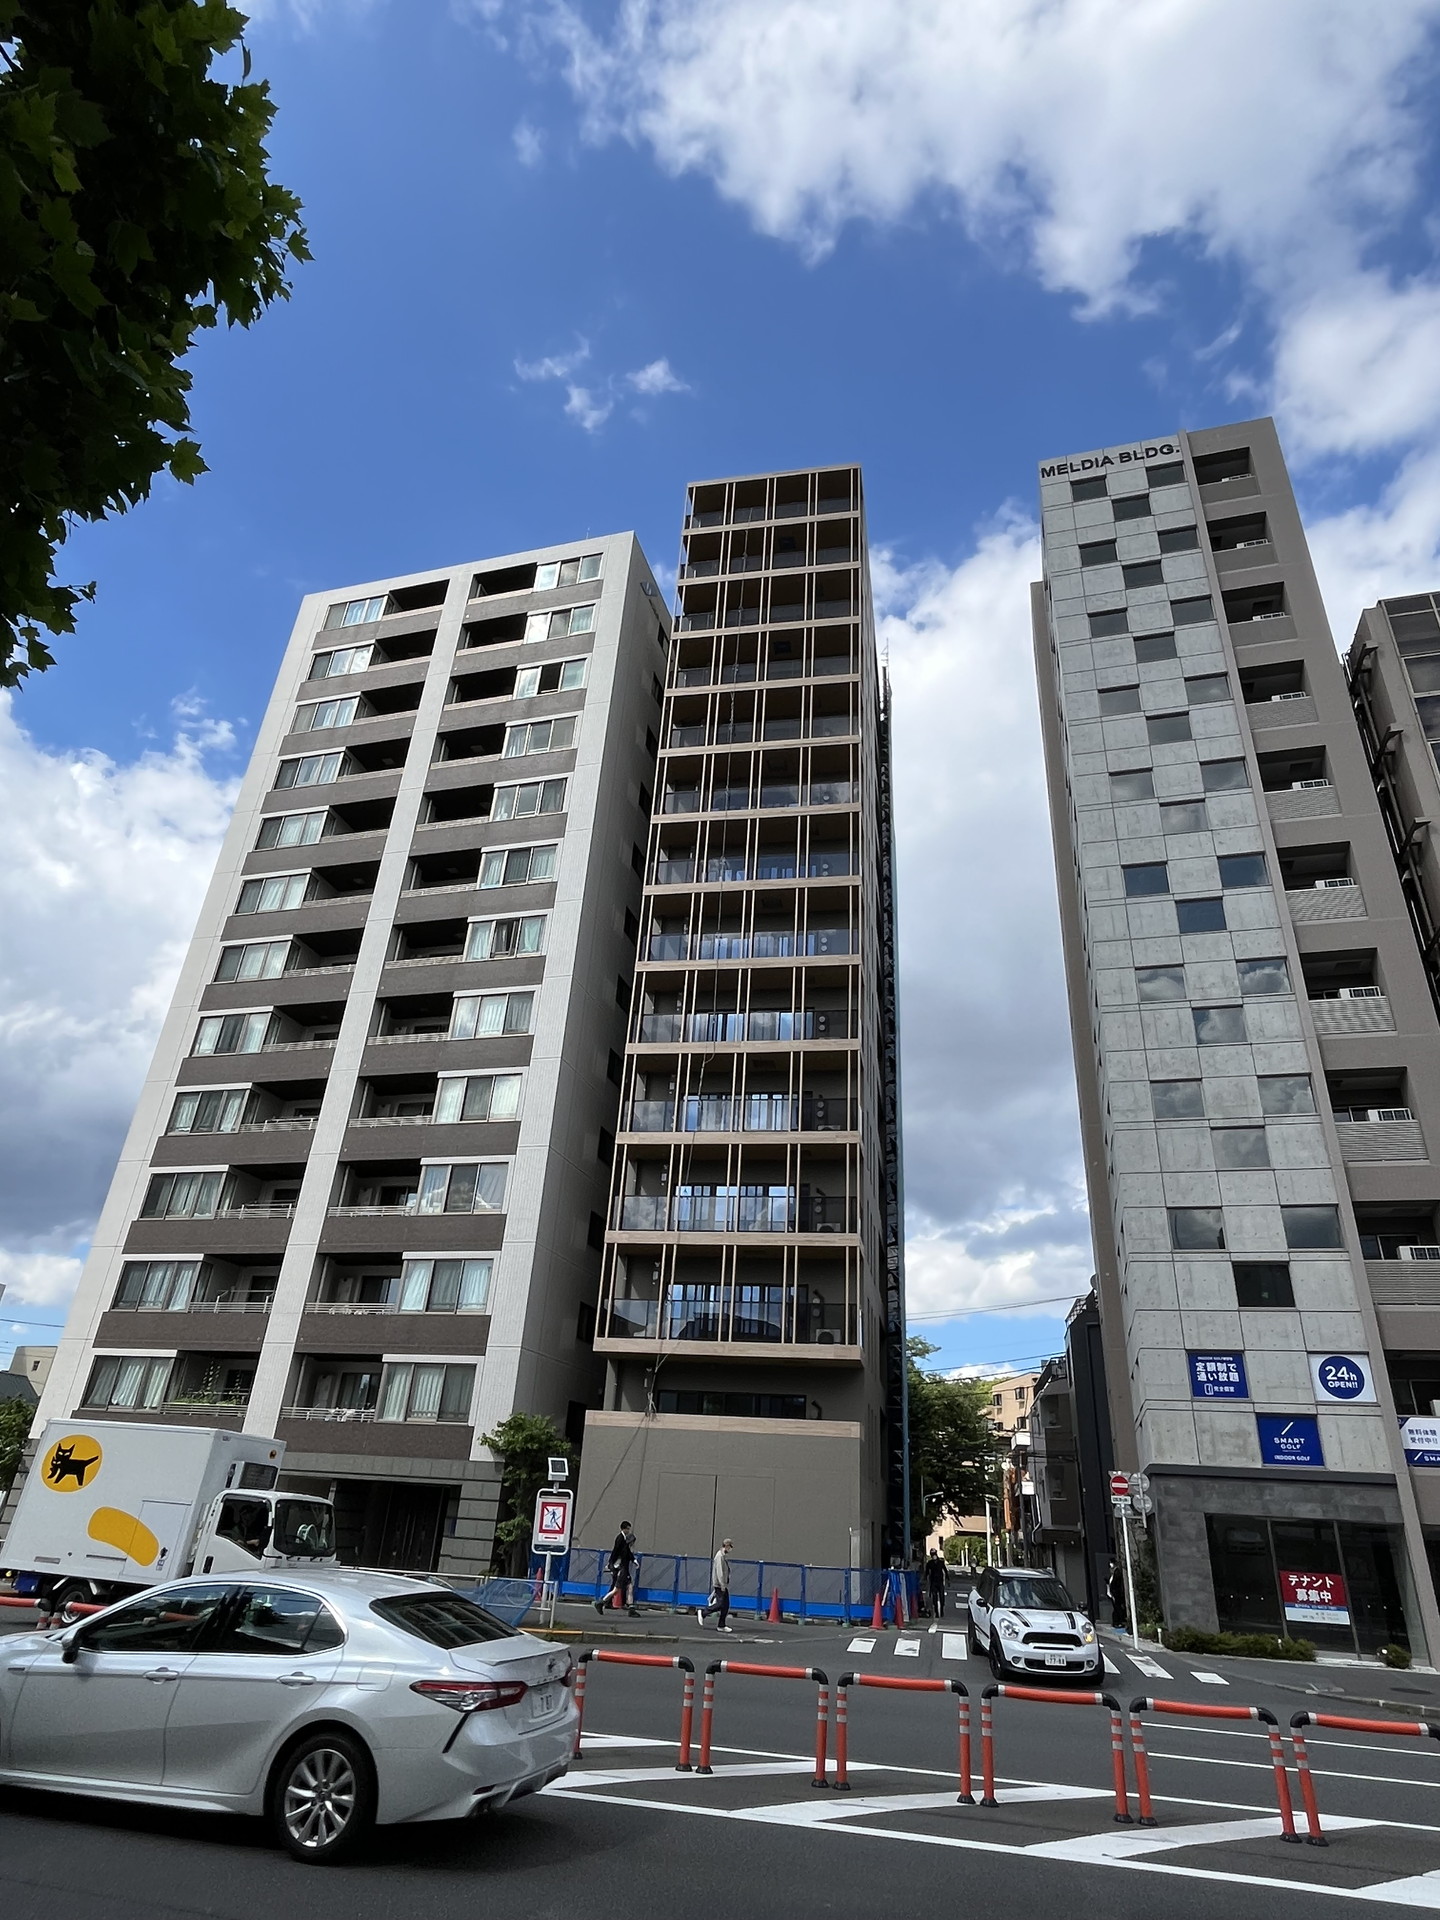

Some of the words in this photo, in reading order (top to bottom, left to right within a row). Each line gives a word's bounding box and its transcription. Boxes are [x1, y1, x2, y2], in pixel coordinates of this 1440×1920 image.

[1041, 455, 1114, 478] MELDIA
[1118, 443, 1180, 464] BLDG.
[1195, 1362, 1237, 1372] 定額制で
[1324, 1365, 1357, 1381] 24h
[1196, 1371, 1240, 1382] 通い放題
[1288, 1574, 1334, 1588] テナント
[1295, 1588, 1332, 1603] 募集中
